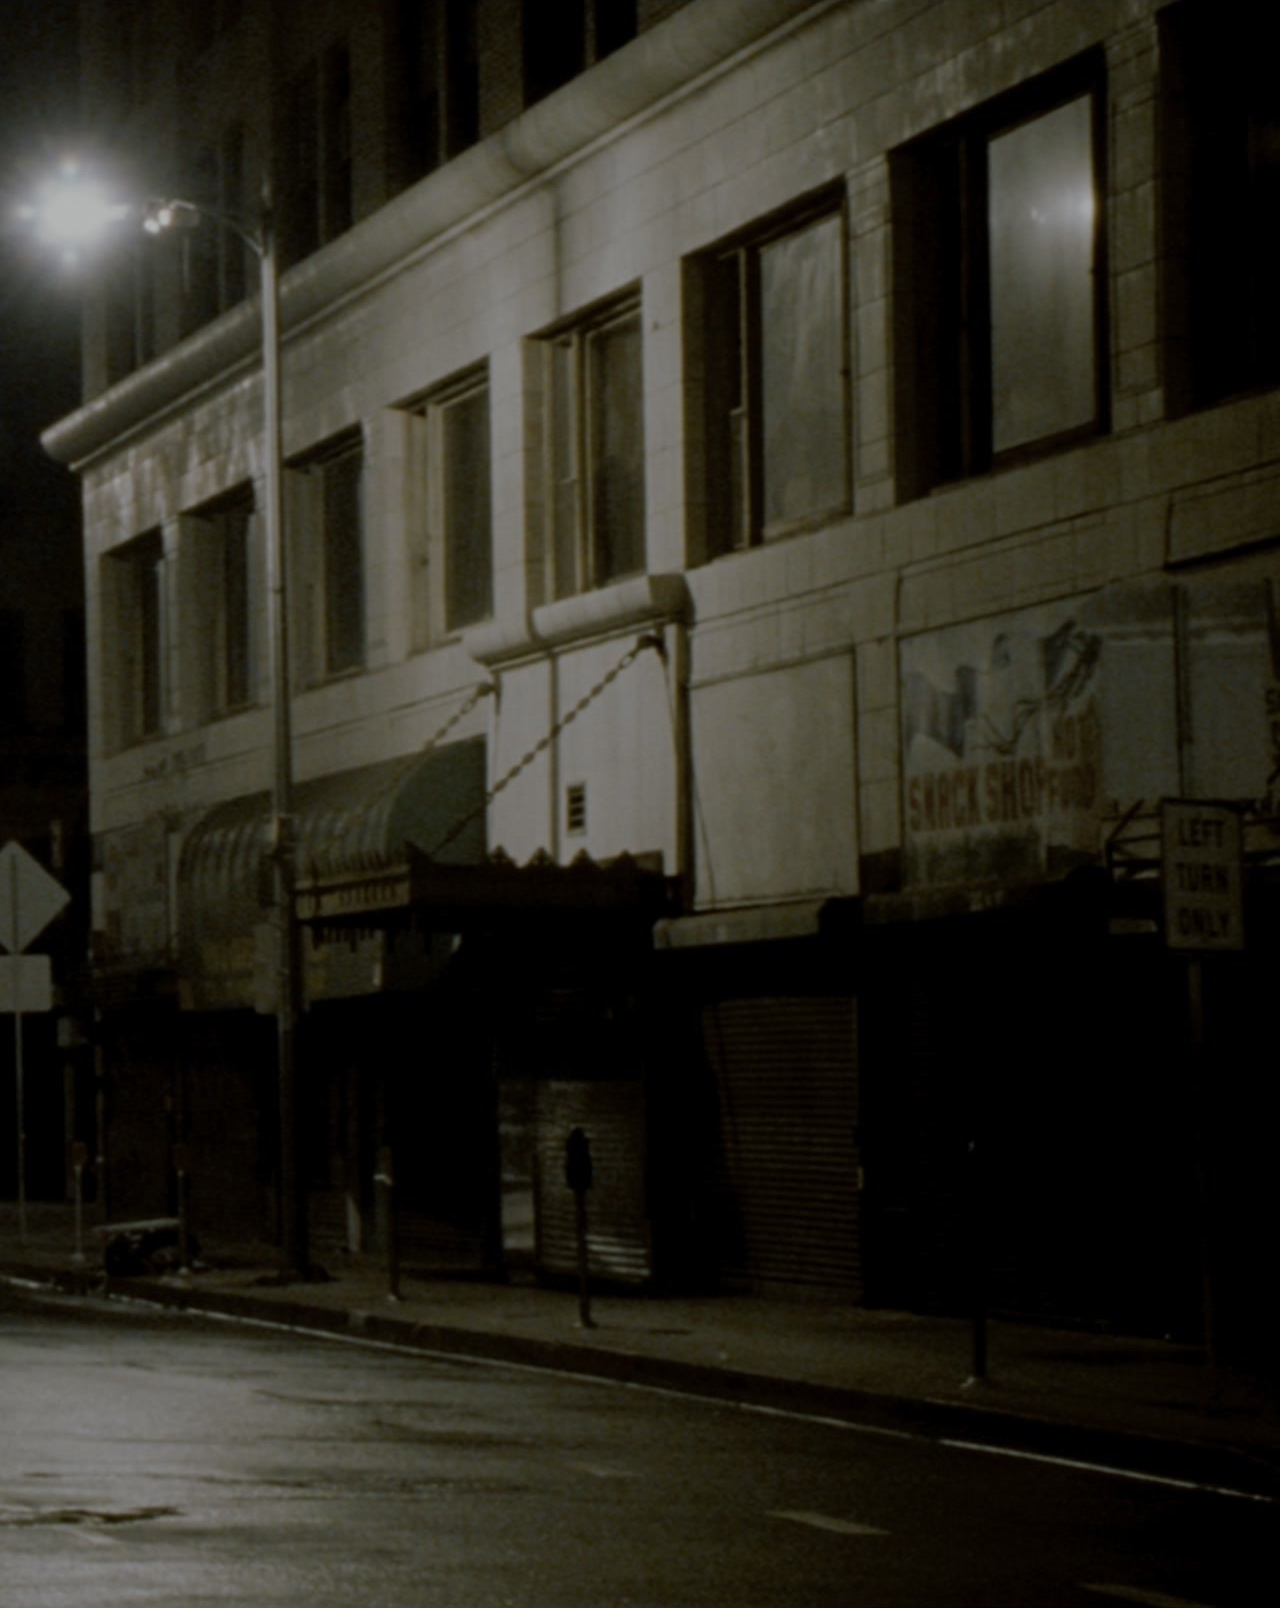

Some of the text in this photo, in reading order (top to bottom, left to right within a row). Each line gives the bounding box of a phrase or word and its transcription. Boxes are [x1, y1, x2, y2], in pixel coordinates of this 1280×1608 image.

[909, 766, 983, 833] SNACK
[1179, 818, 1224, 848] LEFT
[1176, 862, 1229, 893] TURN
[1179, 906, 1230, 938] ONLY
